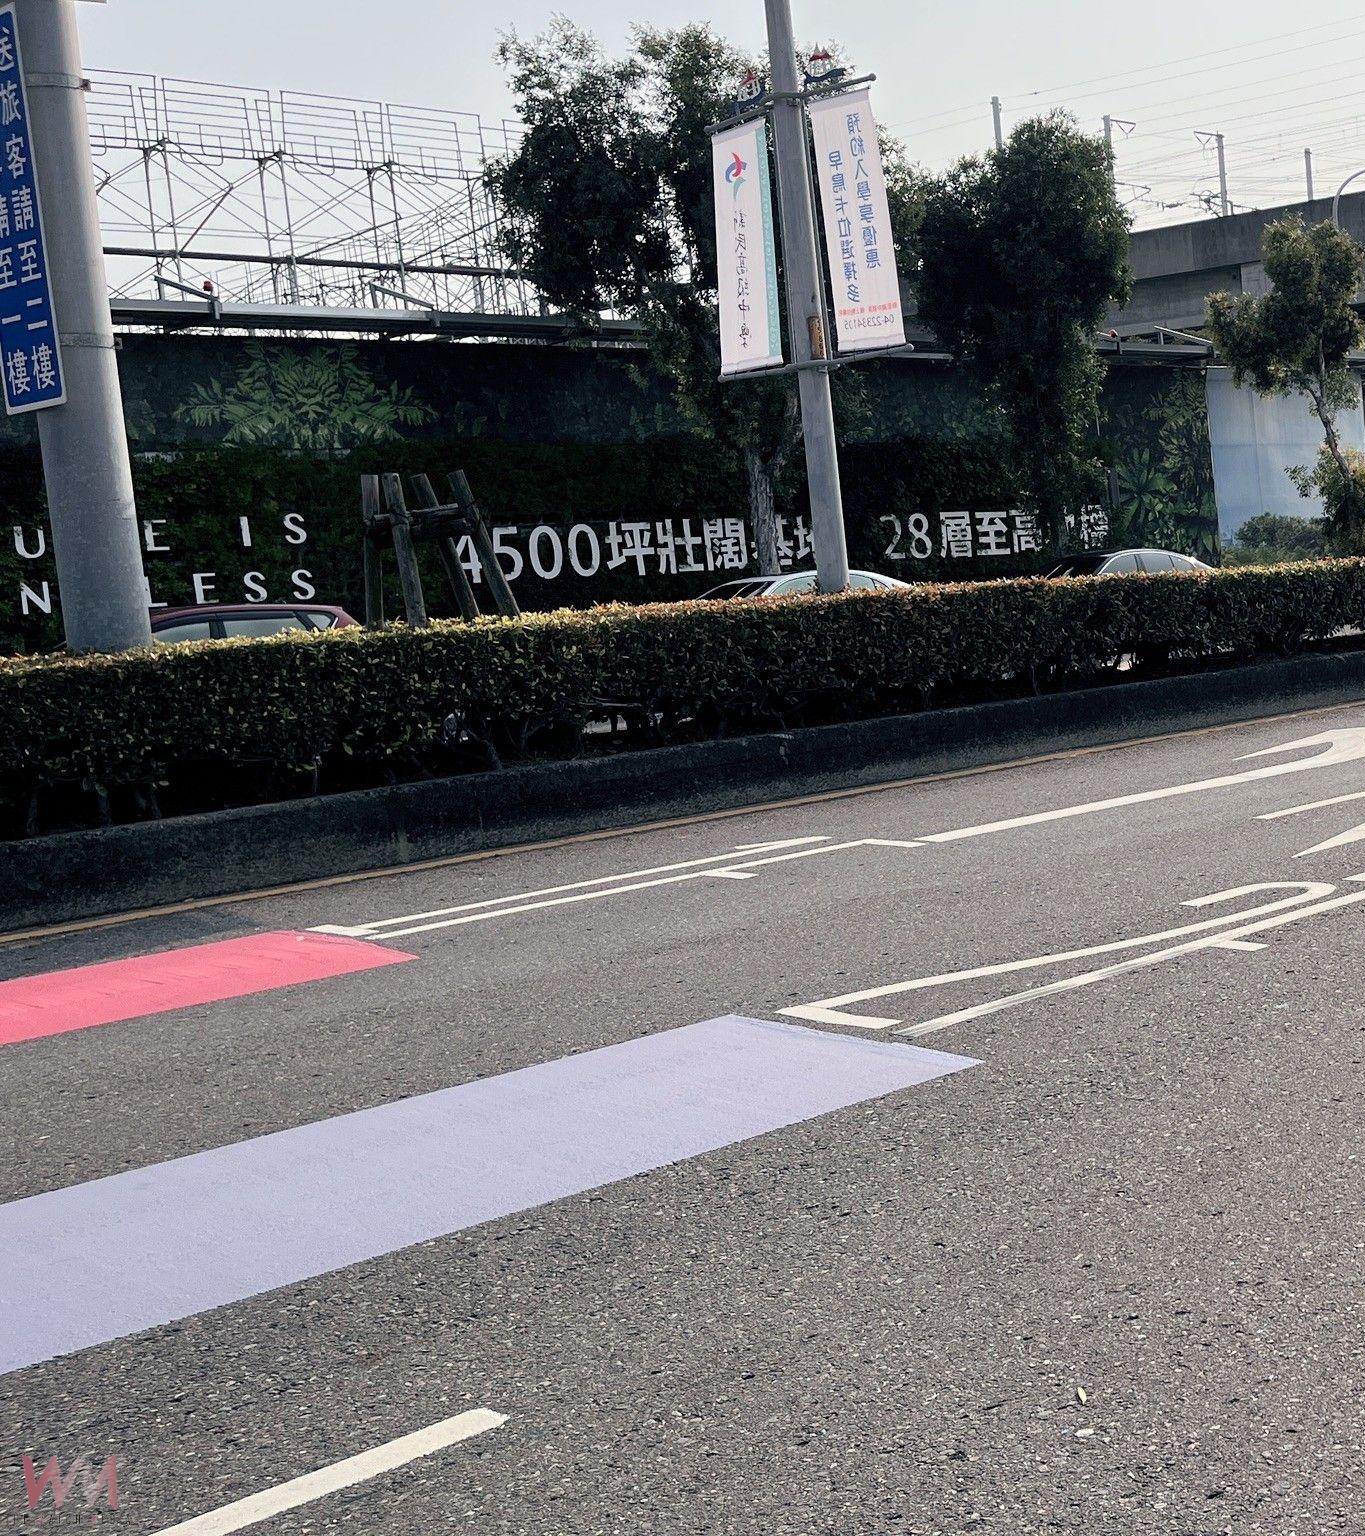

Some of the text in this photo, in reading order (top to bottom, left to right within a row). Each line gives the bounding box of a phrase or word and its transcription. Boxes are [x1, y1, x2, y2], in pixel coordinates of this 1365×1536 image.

[13, 512, 308, 559] UE IS
[879, 504, 1109, 560] 28層至高標
[20, 569, 316, 615] NLESS
